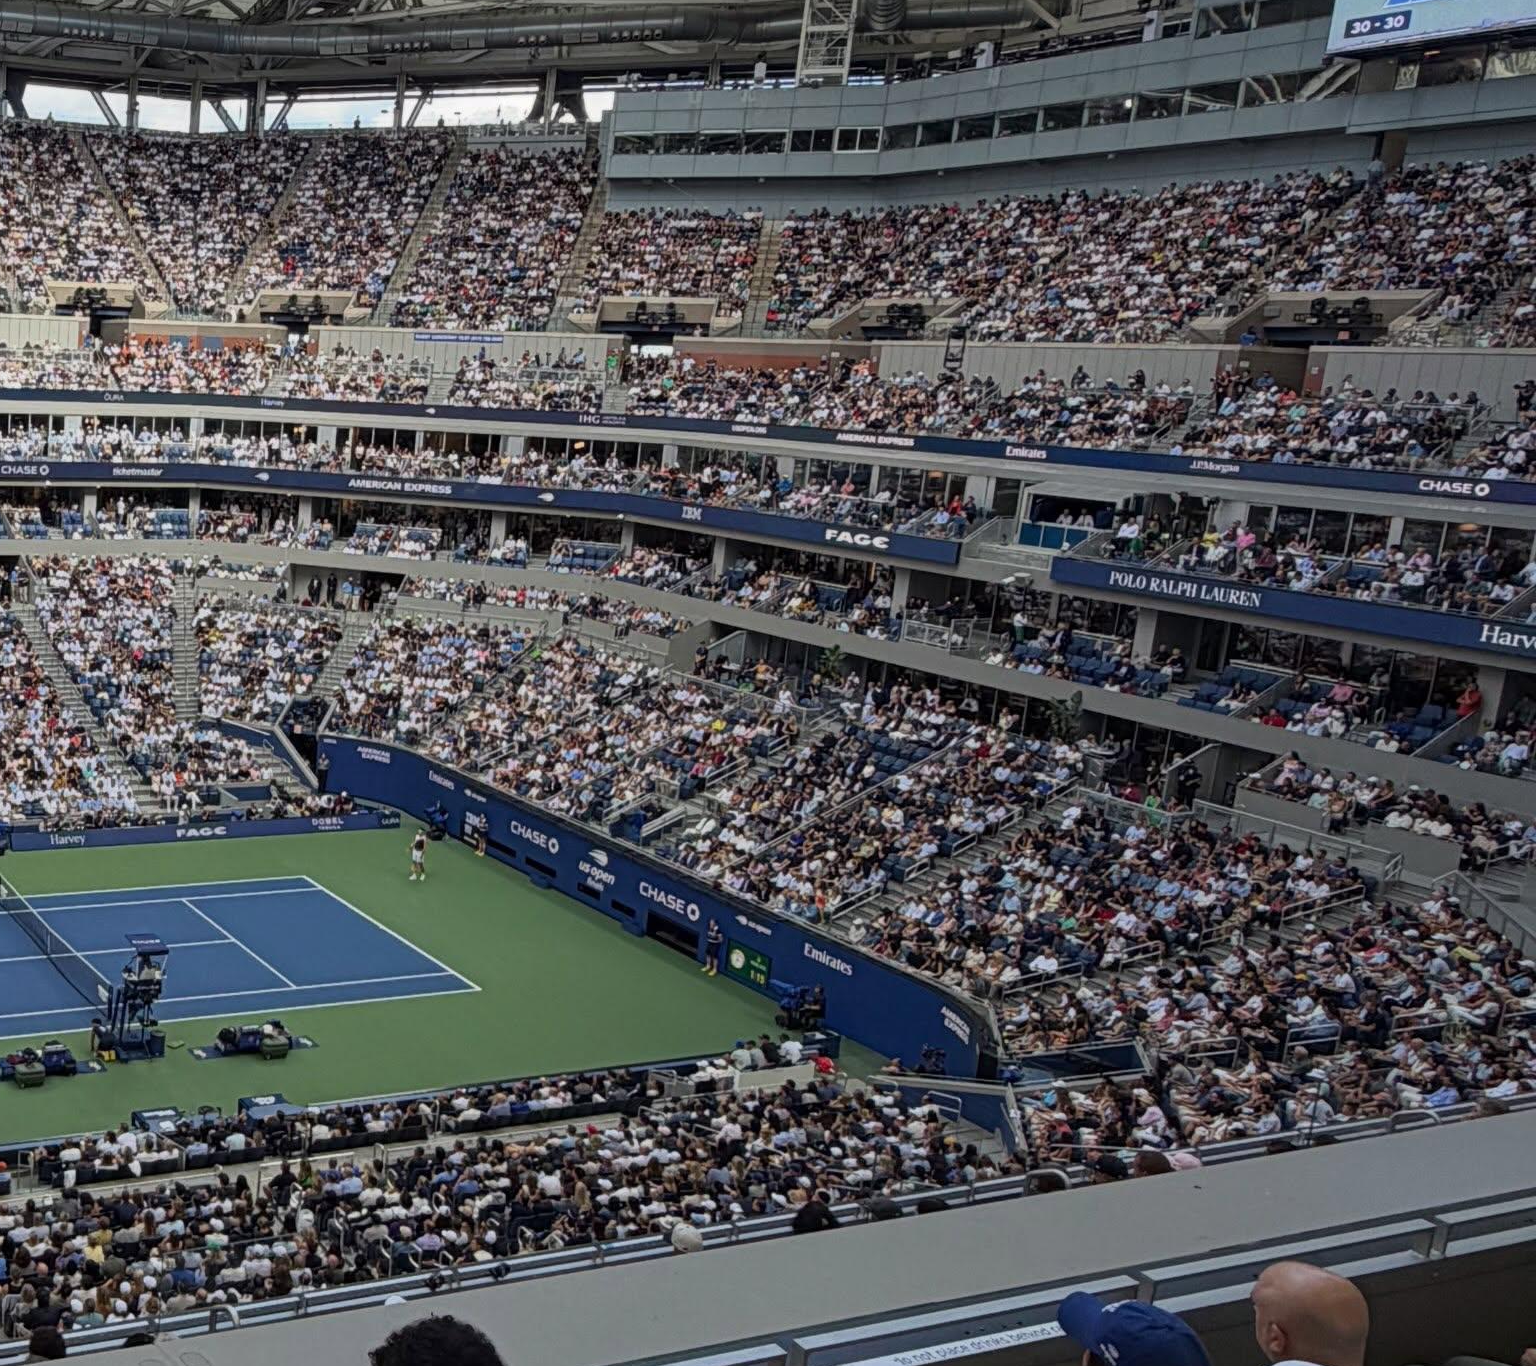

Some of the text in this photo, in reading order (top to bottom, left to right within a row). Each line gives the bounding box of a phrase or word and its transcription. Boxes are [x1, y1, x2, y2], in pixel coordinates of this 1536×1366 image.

[1350, 19, 1371, 34] 30
[1383, 14, 1405, 30] 30
[578, 414, 600, 424] IHG
[836, 433, 915, 447] AMERICAN EXPRESS
[1005, 445, 1047, 460] Emirates
[1, 465, 38, 475] CHASE
[112, 466, 163, 477] ticketmaster
[348, 479, 452, 494] AMERICAN EXPRESS
[1419, 479, 1473, 494] CHASE
[681, 506, 703, 520] IBM
[825, 528, 890, 549] FAGE
[1109, 571, 1262, 608] POLO RALPH LAUREN
[1479, 624, 1536, 649] Harv
[312, 817, 344, 826] DOBEL
[176, 826, 228, 838] FAGE
[510, 821, 547, 849] CHASE
[50, 834, 86, 846] Harvey
[639, 881, 685, 915] CHASE
[804, 942, 853, 976] Emirates
